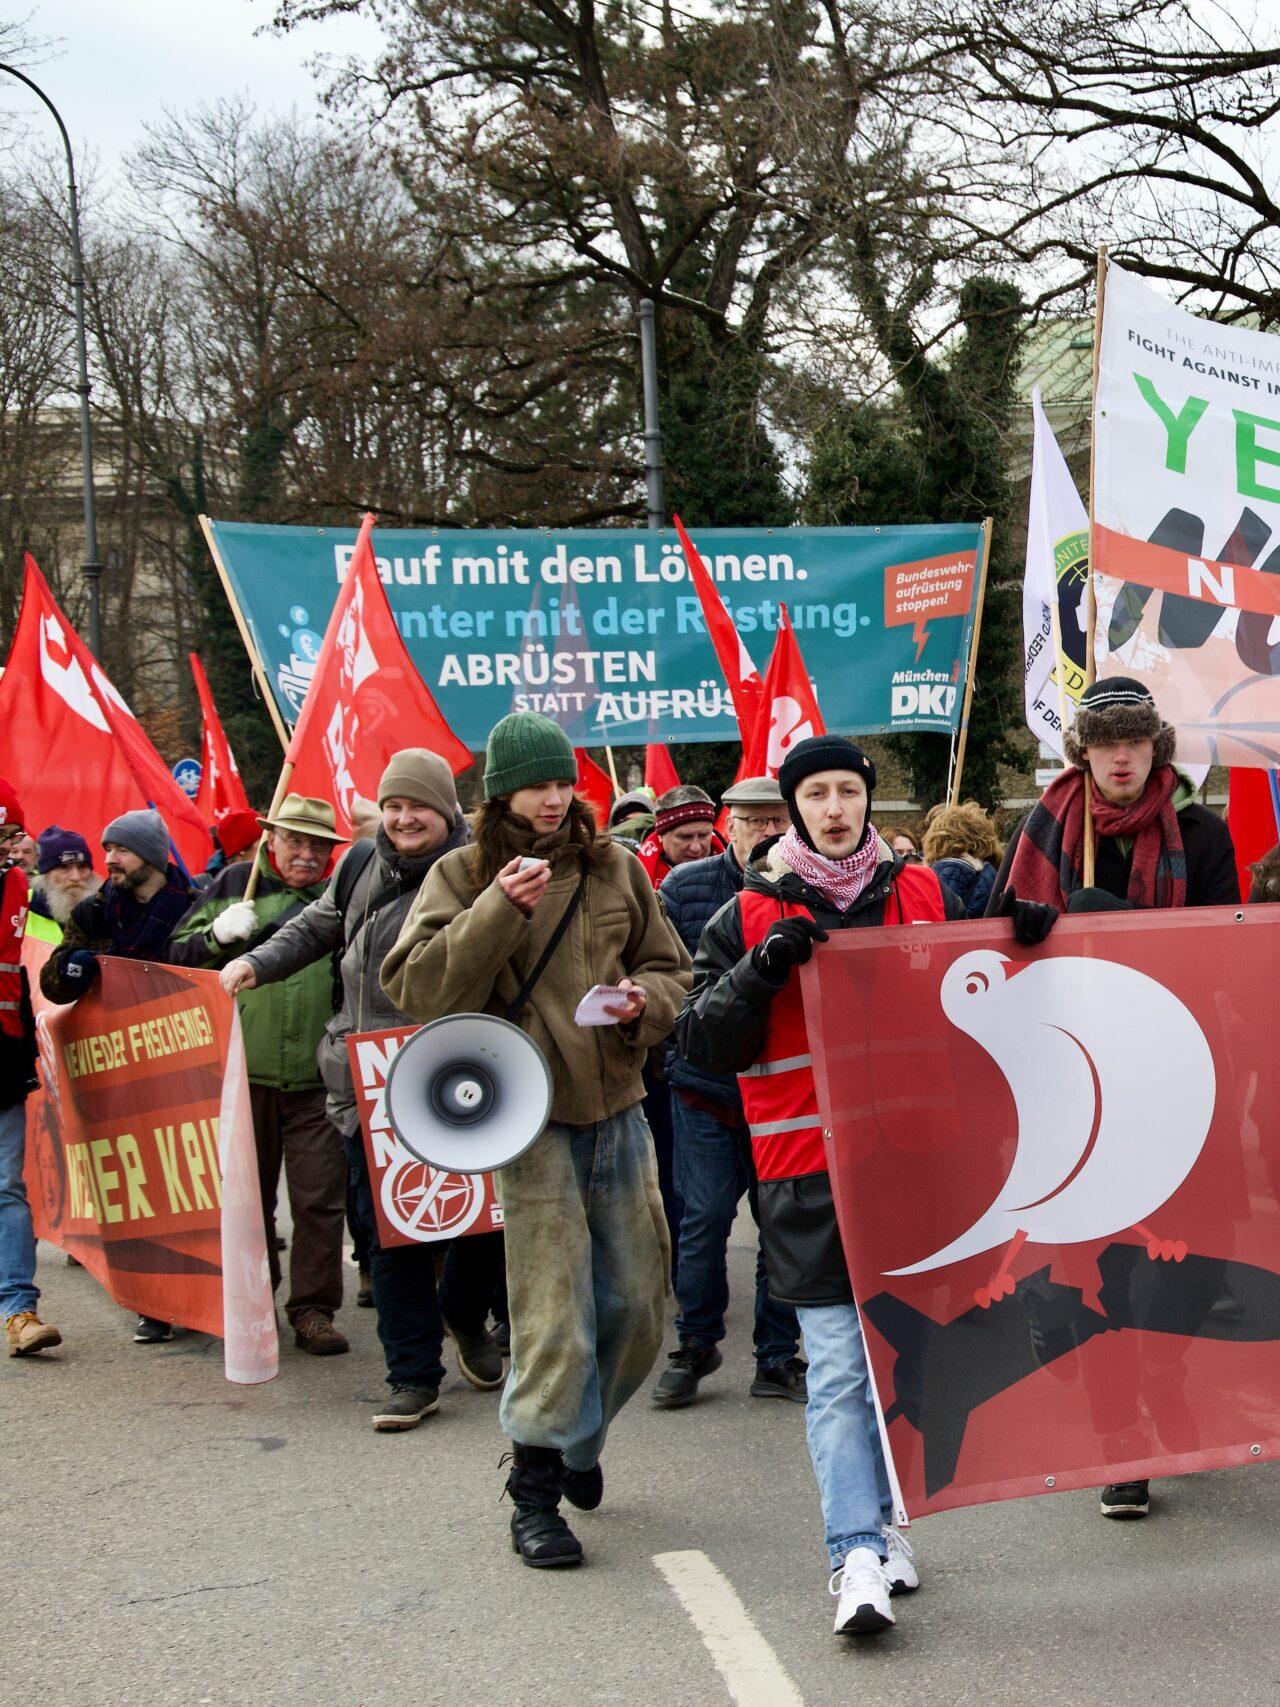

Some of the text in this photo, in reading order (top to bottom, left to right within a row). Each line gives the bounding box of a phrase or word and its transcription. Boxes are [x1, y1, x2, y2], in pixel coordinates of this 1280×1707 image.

[1166, 327, 1196, 348] THE
[1127, 329, 1176, 363] FIGHT
[1182, 357, 1261, 390] AGAINST
[452, 545, 530, 585] mit
[540, 545, 622, 584] den
[896, 561, 974, 585] Bundeswehr-
[896, 578, 963, 600] aufrüstung
[896, 593, 949, 614] stoppen!
[504, 598, 581, 637] mit
[592, 596, 665, 635] der
[676, 595, 871, 637] Rstung.
[438, 644, 657, 687] ABRÜSTEN
[891, 669, 950, 684] München
[515, 692, 586, 714] STATT
[891, 684, 957, 717] DKP
